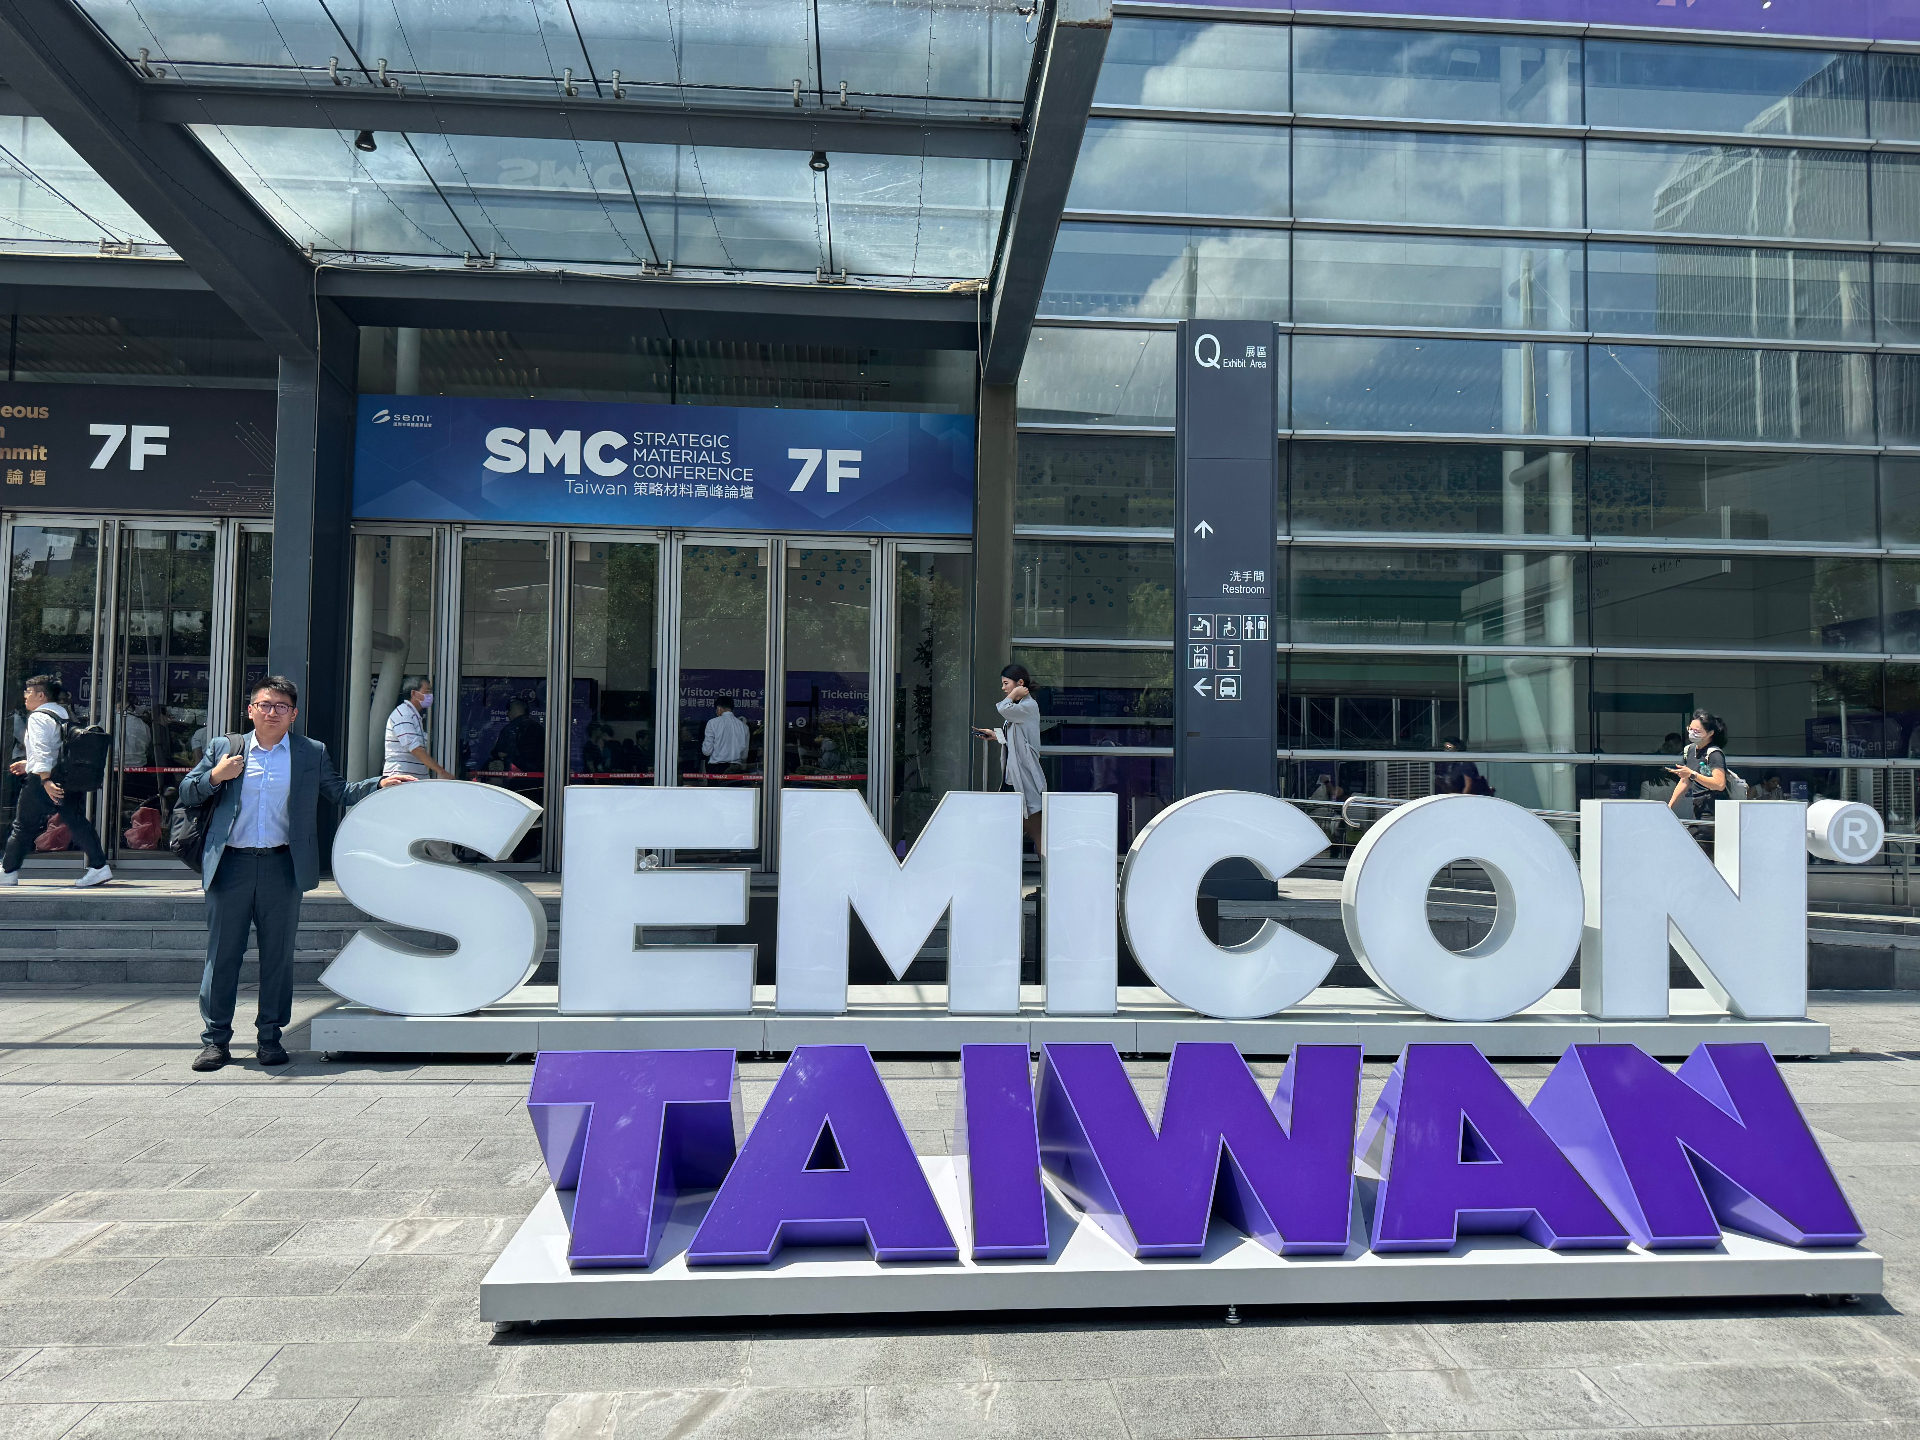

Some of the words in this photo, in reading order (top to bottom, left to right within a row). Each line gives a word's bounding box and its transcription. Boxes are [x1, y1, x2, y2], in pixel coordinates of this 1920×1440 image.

[1194, 333, 1221, 370] Q
[1245, 345, 1267, 358] 展區
[1223, 358, 1246, 368] Exhibit
[1249, 359, 1267, 369] Area
[393, 413, 430, 422] semi
[89, 423, 170, 471] 7F
[633, 431, 730, 449] STRATEGIC
[482, 426, 629, 477] SMC
[633, 448, 731, 465] MATERIALS
[6, 468, 47, 486] 論壇
[633, 464, 754, 482] CONFERENCE
[787, 447, 862, 493] 7F
[564, 479, 628, 496] Taiwan
[633, 481, 754, 500] 策略材料高峰論壇
[1229, 570, 1265, 583] 洗手間
[1222, 583, 1265, 594] Restroom
[174, 670, 190, 680] 7F
[172, 693, 189, 703] 7F
[679, 687, 740, 697] Visitor-Self
[820, 689, 869, 701] Ticketing
[318, 778, 1808, 1021] SEMICON
[527, 1043, 1866, 1267] TAIWAN
